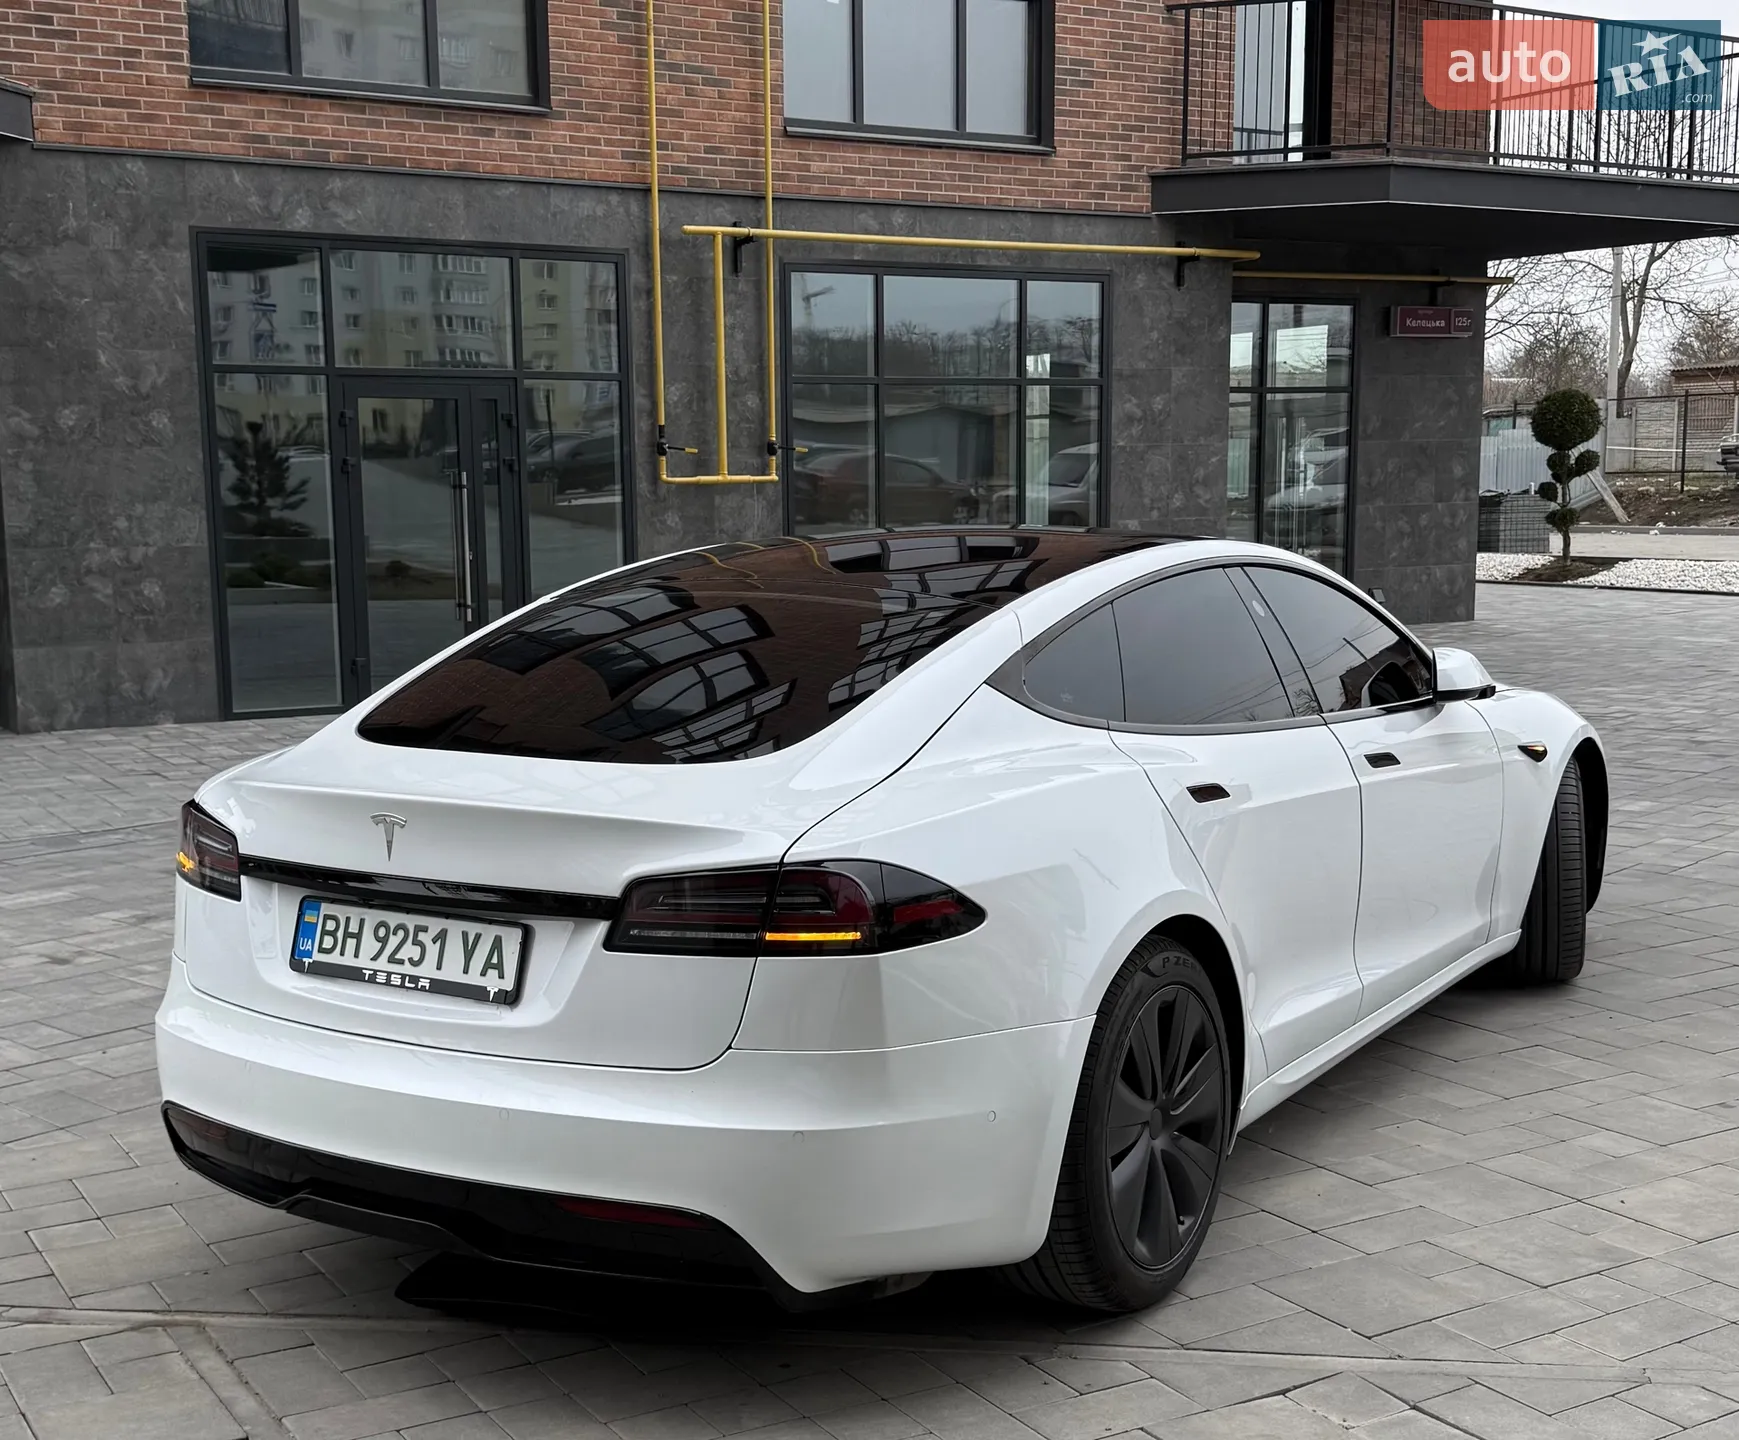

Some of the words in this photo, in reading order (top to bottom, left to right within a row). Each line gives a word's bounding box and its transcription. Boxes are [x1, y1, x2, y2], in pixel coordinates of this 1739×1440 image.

[299, 937, 313, 952] UA
[318, 913, 366, 959] BH
[370, 920, 448, 971] 9251
[461, 930, 505, 980] YA
[362, 969, 431, 991] TESLA
